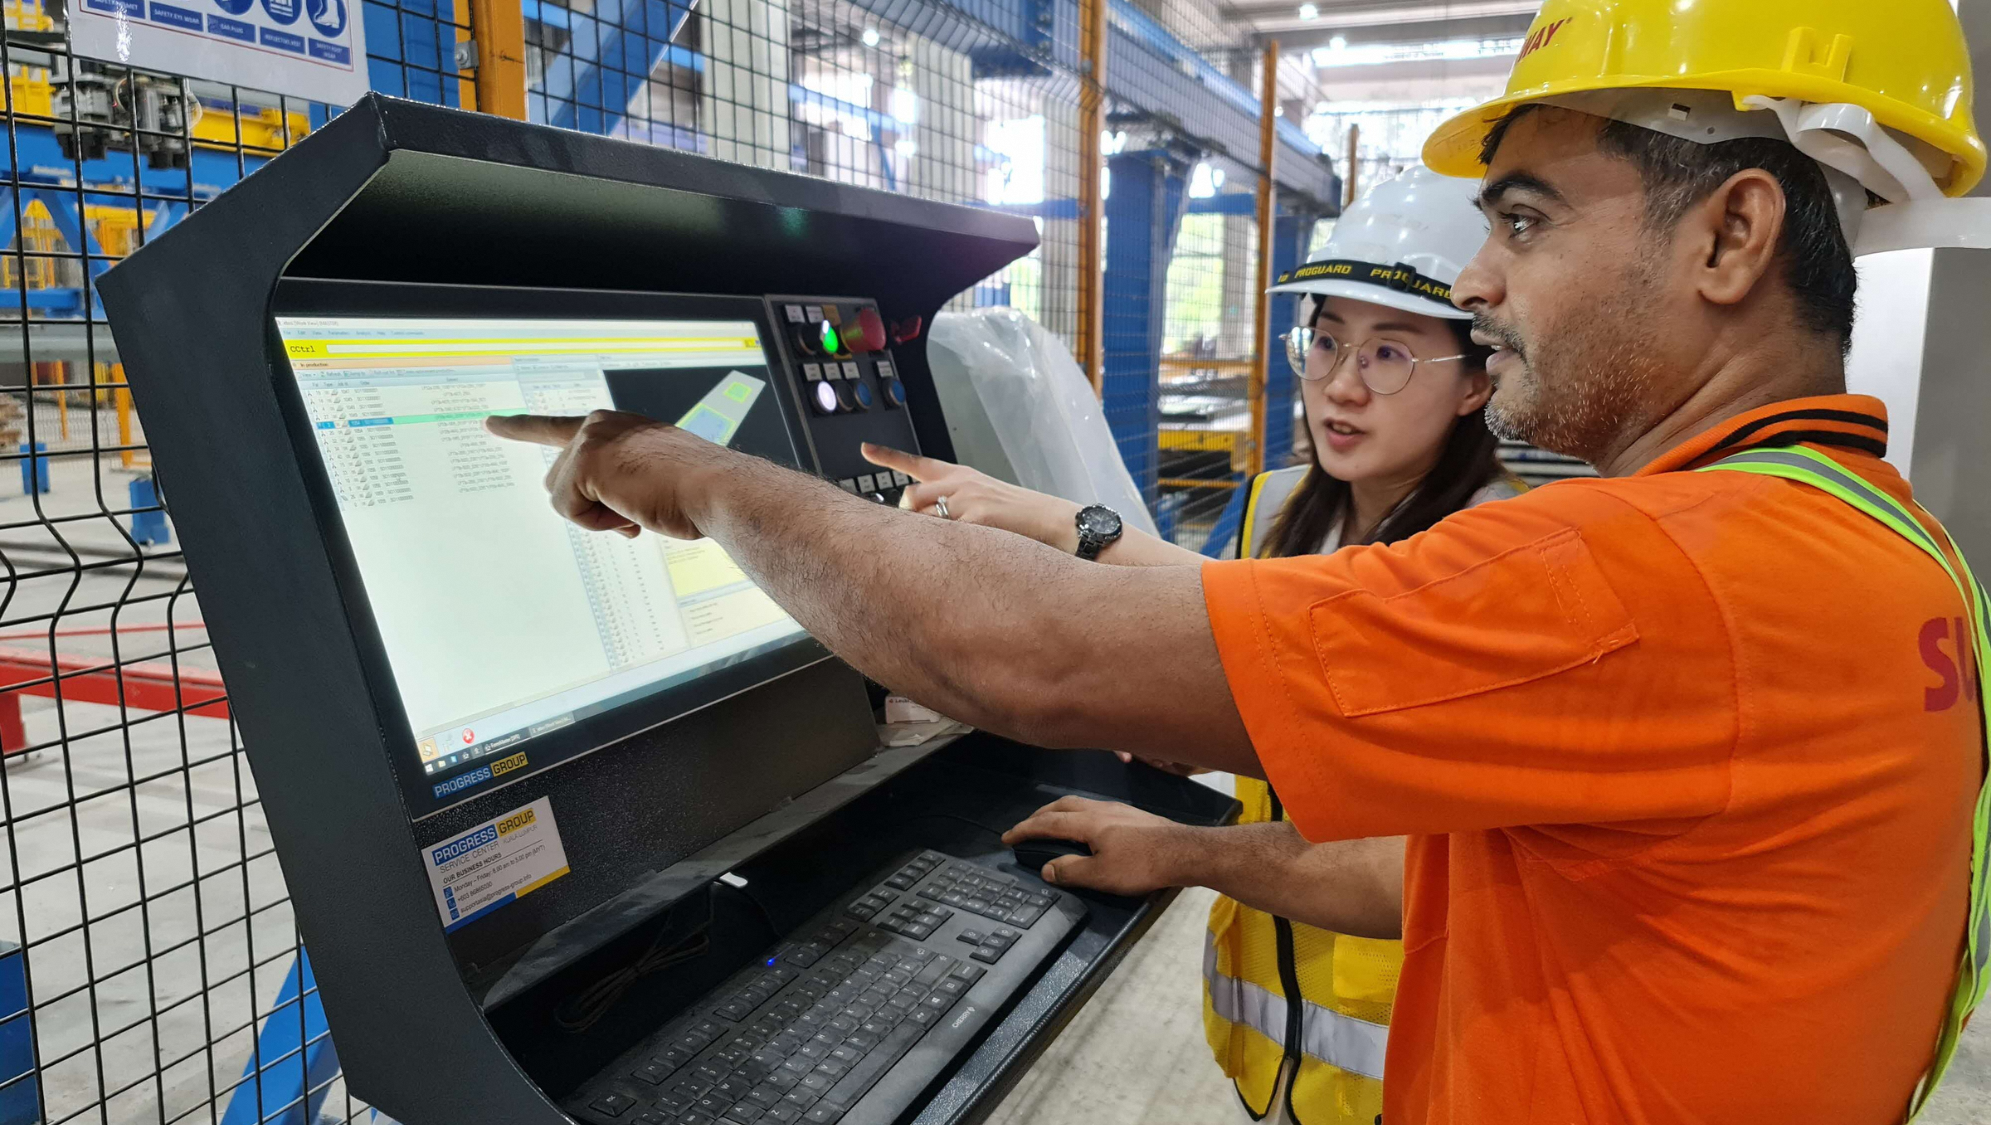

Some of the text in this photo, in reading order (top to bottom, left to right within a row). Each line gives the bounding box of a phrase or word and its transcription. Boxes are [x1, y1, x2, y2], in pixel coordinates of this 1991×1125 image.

[154, 9, 173, 18] SAFETY
[184, 16, 200, 25] WEAR
[231, 26, 243, 34] PLUG
[1294, 264, 1352, 279] PROGUARD
[290, 345, 316, 353] CCtrl
[434, 754, 526, 797] PROGRESS GROUP
[434, 810, 535, 864] PROGRESS GROUP
[503, 824, 538, 845] KUALA LUMPUR
[439, 840, 500, 874] SERVICE CENTER
[443, 852, 502, 884] OUR BUSINESS HOURS
[454, 880, 473, 892] Monday
[951, 1009, 971, 1028] CHERRY
